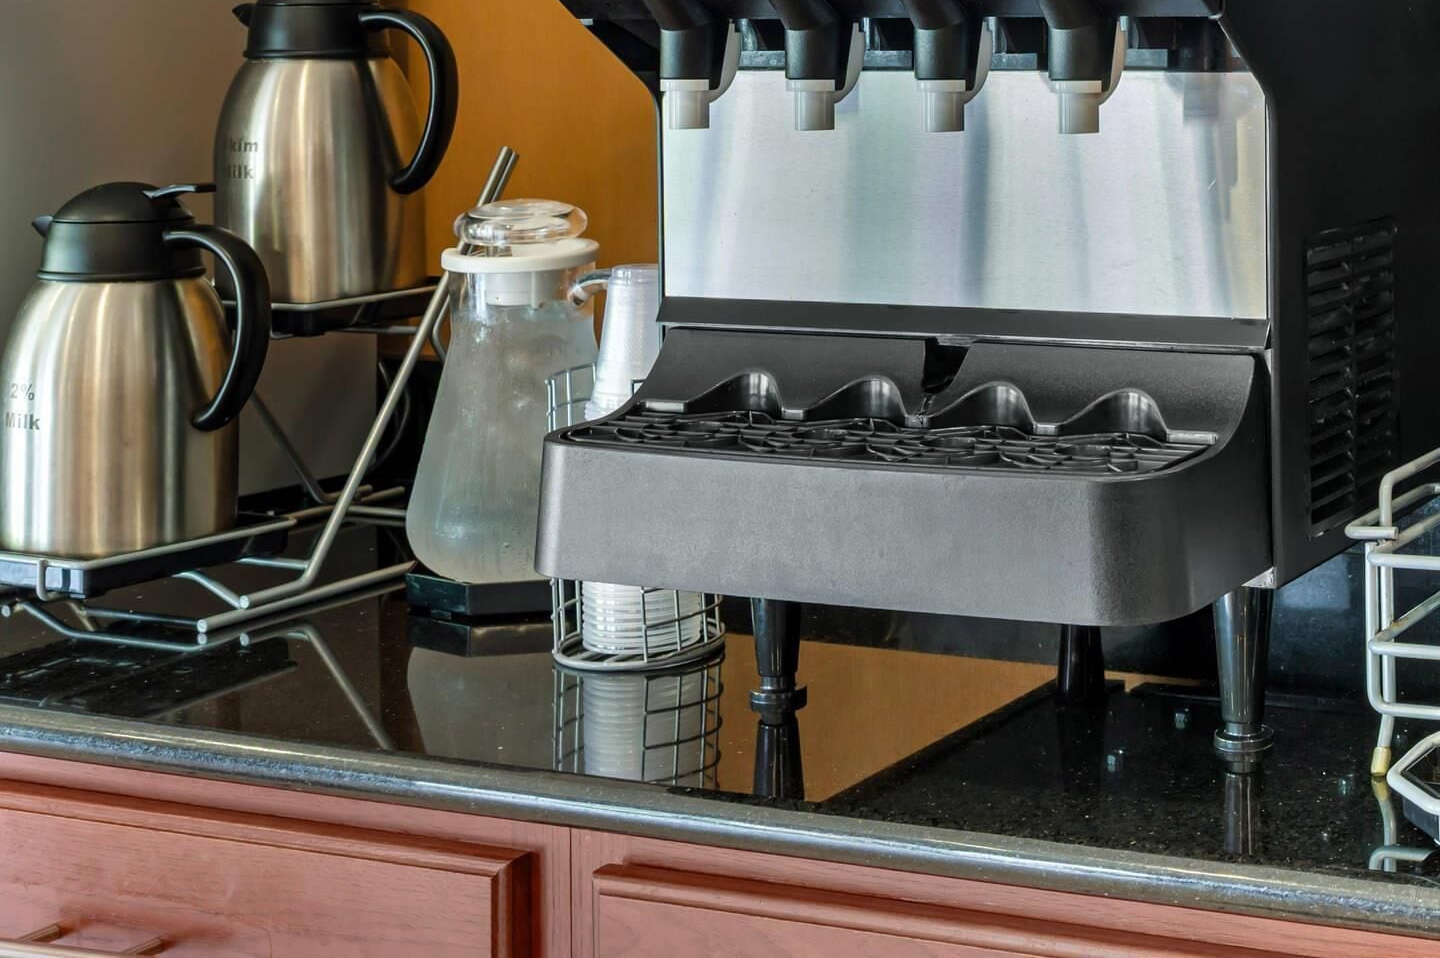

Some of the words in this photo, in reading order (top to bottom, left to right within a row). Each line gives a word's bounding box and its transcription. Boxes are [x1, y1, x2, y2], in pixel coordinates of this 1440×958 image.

[229, 138, 258, 152] kim
[228, 164, 254, 179] ilk
[10, 383, 35, 401] 2%
[5, 411, 40, 430] Milk
